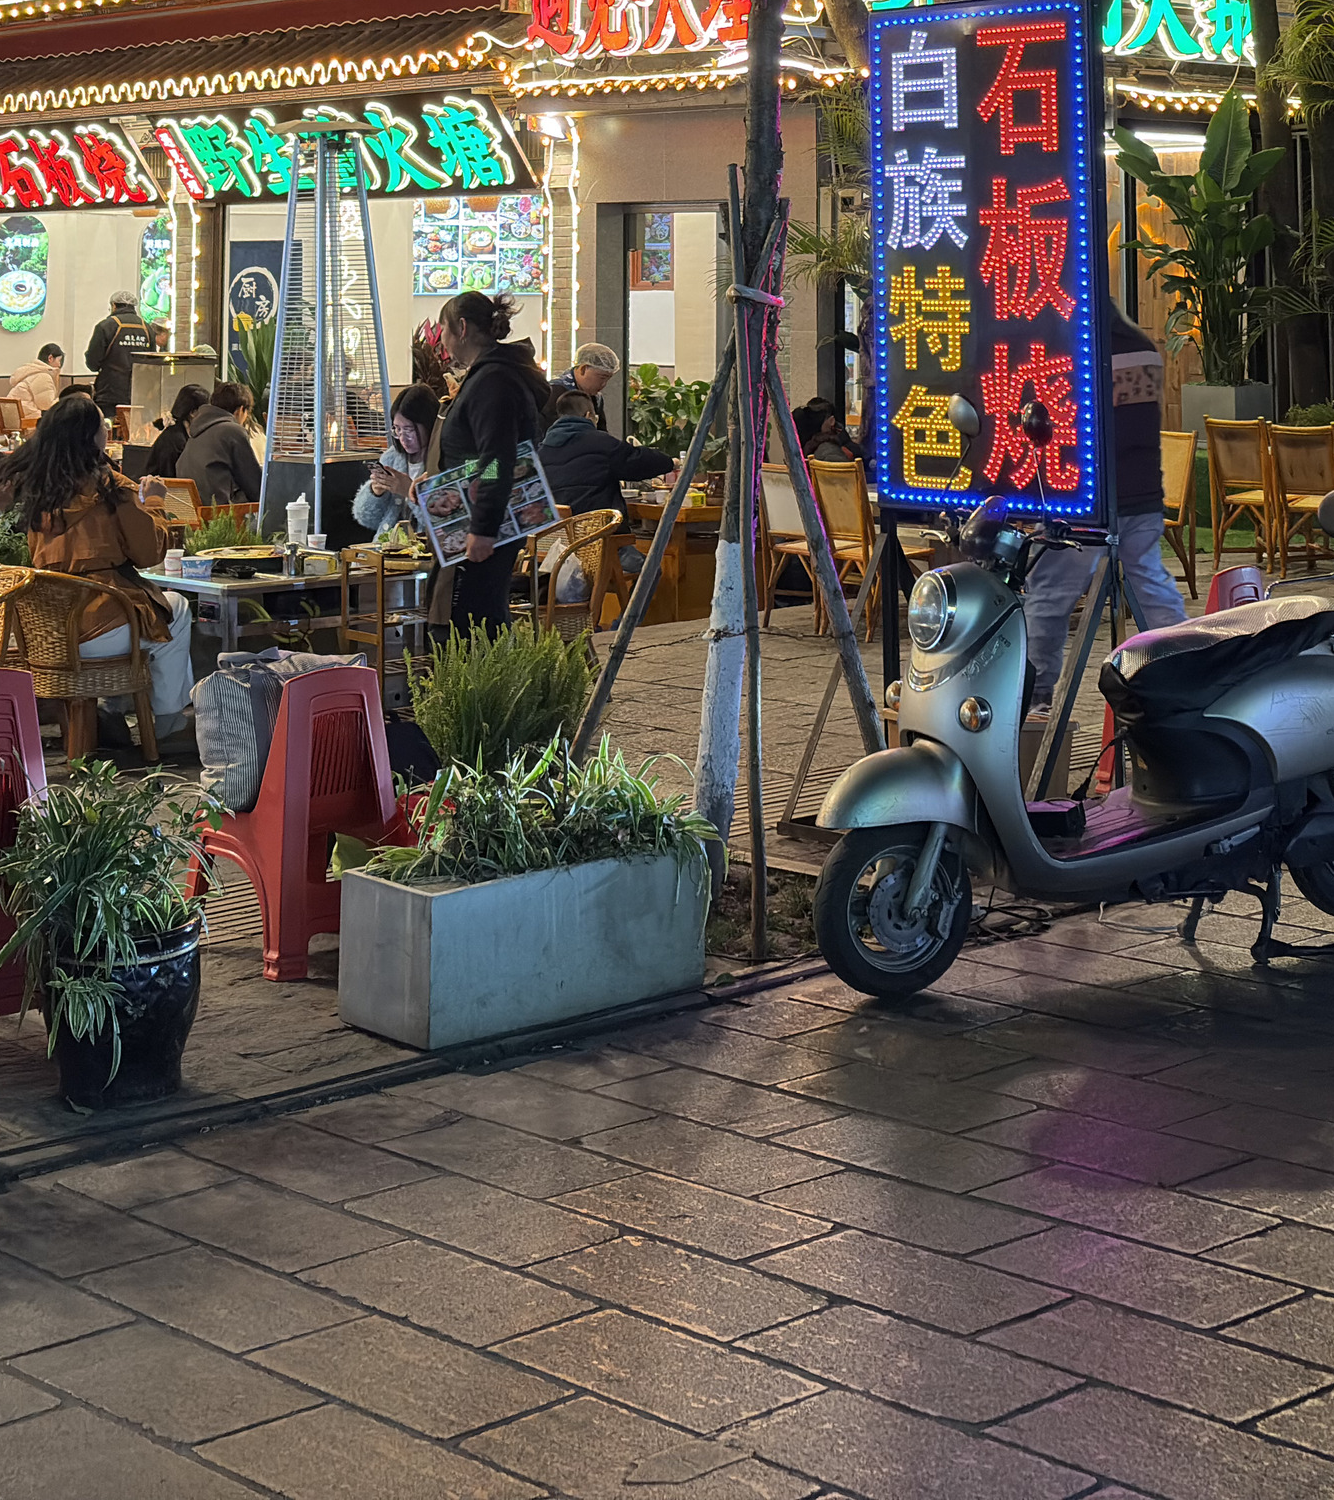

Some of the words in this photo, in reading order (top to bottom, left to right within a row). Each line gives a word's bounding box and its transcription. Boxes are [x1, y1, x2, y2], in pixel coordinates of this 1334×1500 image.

[238, 277, 270, 318] 厨房
[884, 30, 973, 492] 白族特色
[975, 20, 1080, 492] 石板烧
